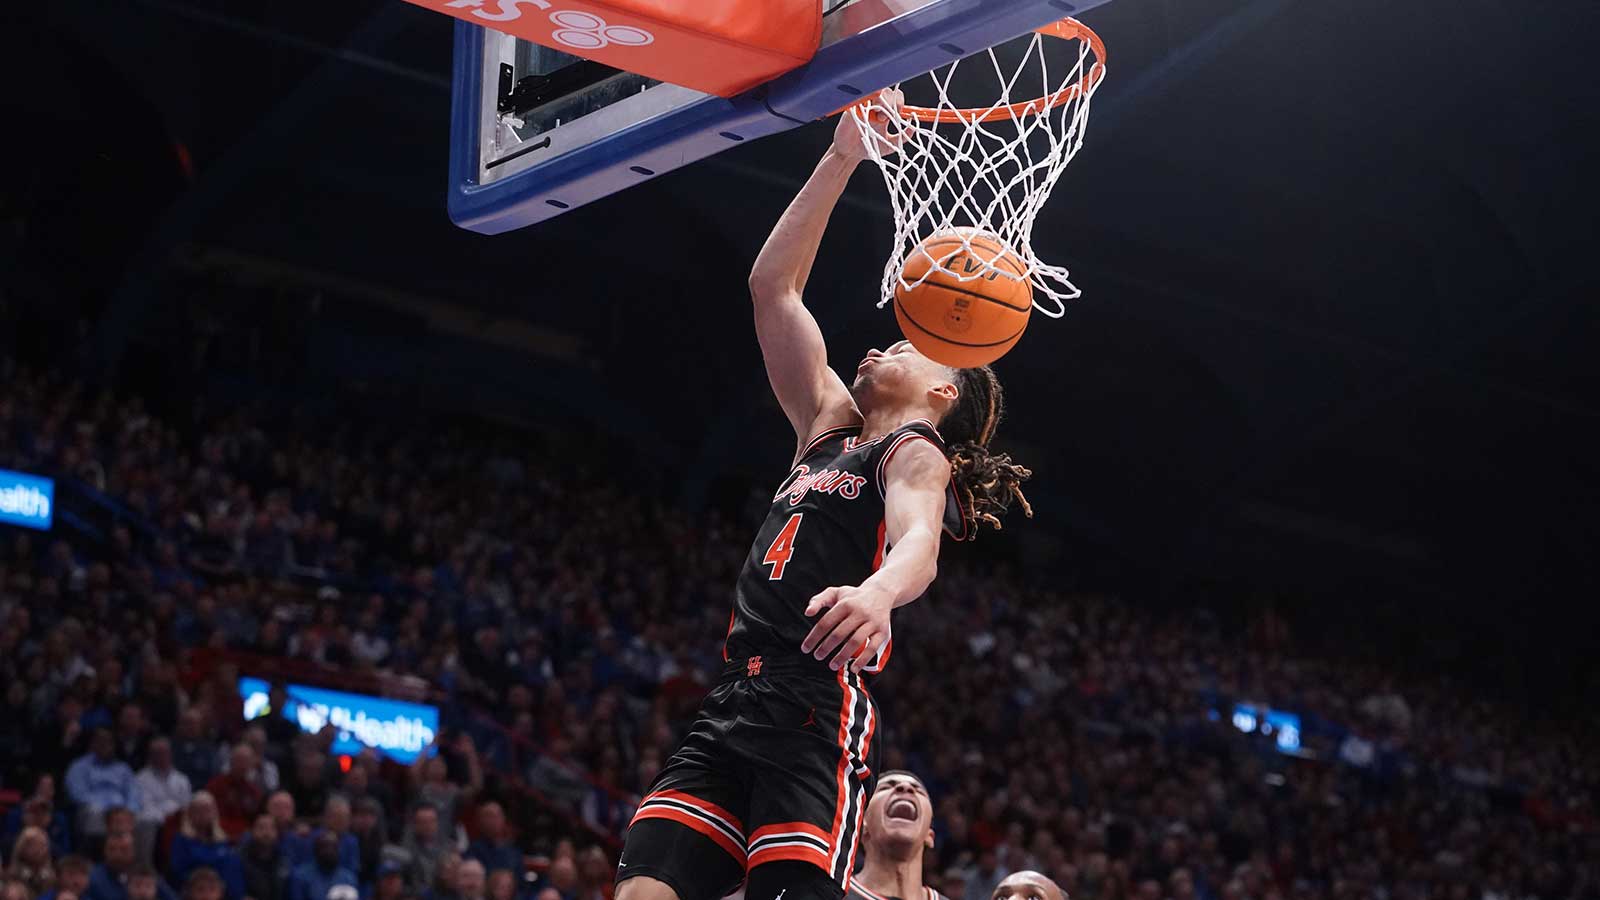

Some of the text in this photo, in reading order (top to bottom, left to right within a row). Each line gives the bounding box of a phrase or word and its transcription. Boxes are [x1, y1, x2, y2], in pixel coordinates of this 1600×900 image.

[0, 484, 49, 518] alth
[773, 465, 867, 506] Cougars
[763, 513, 803, 580] 4
